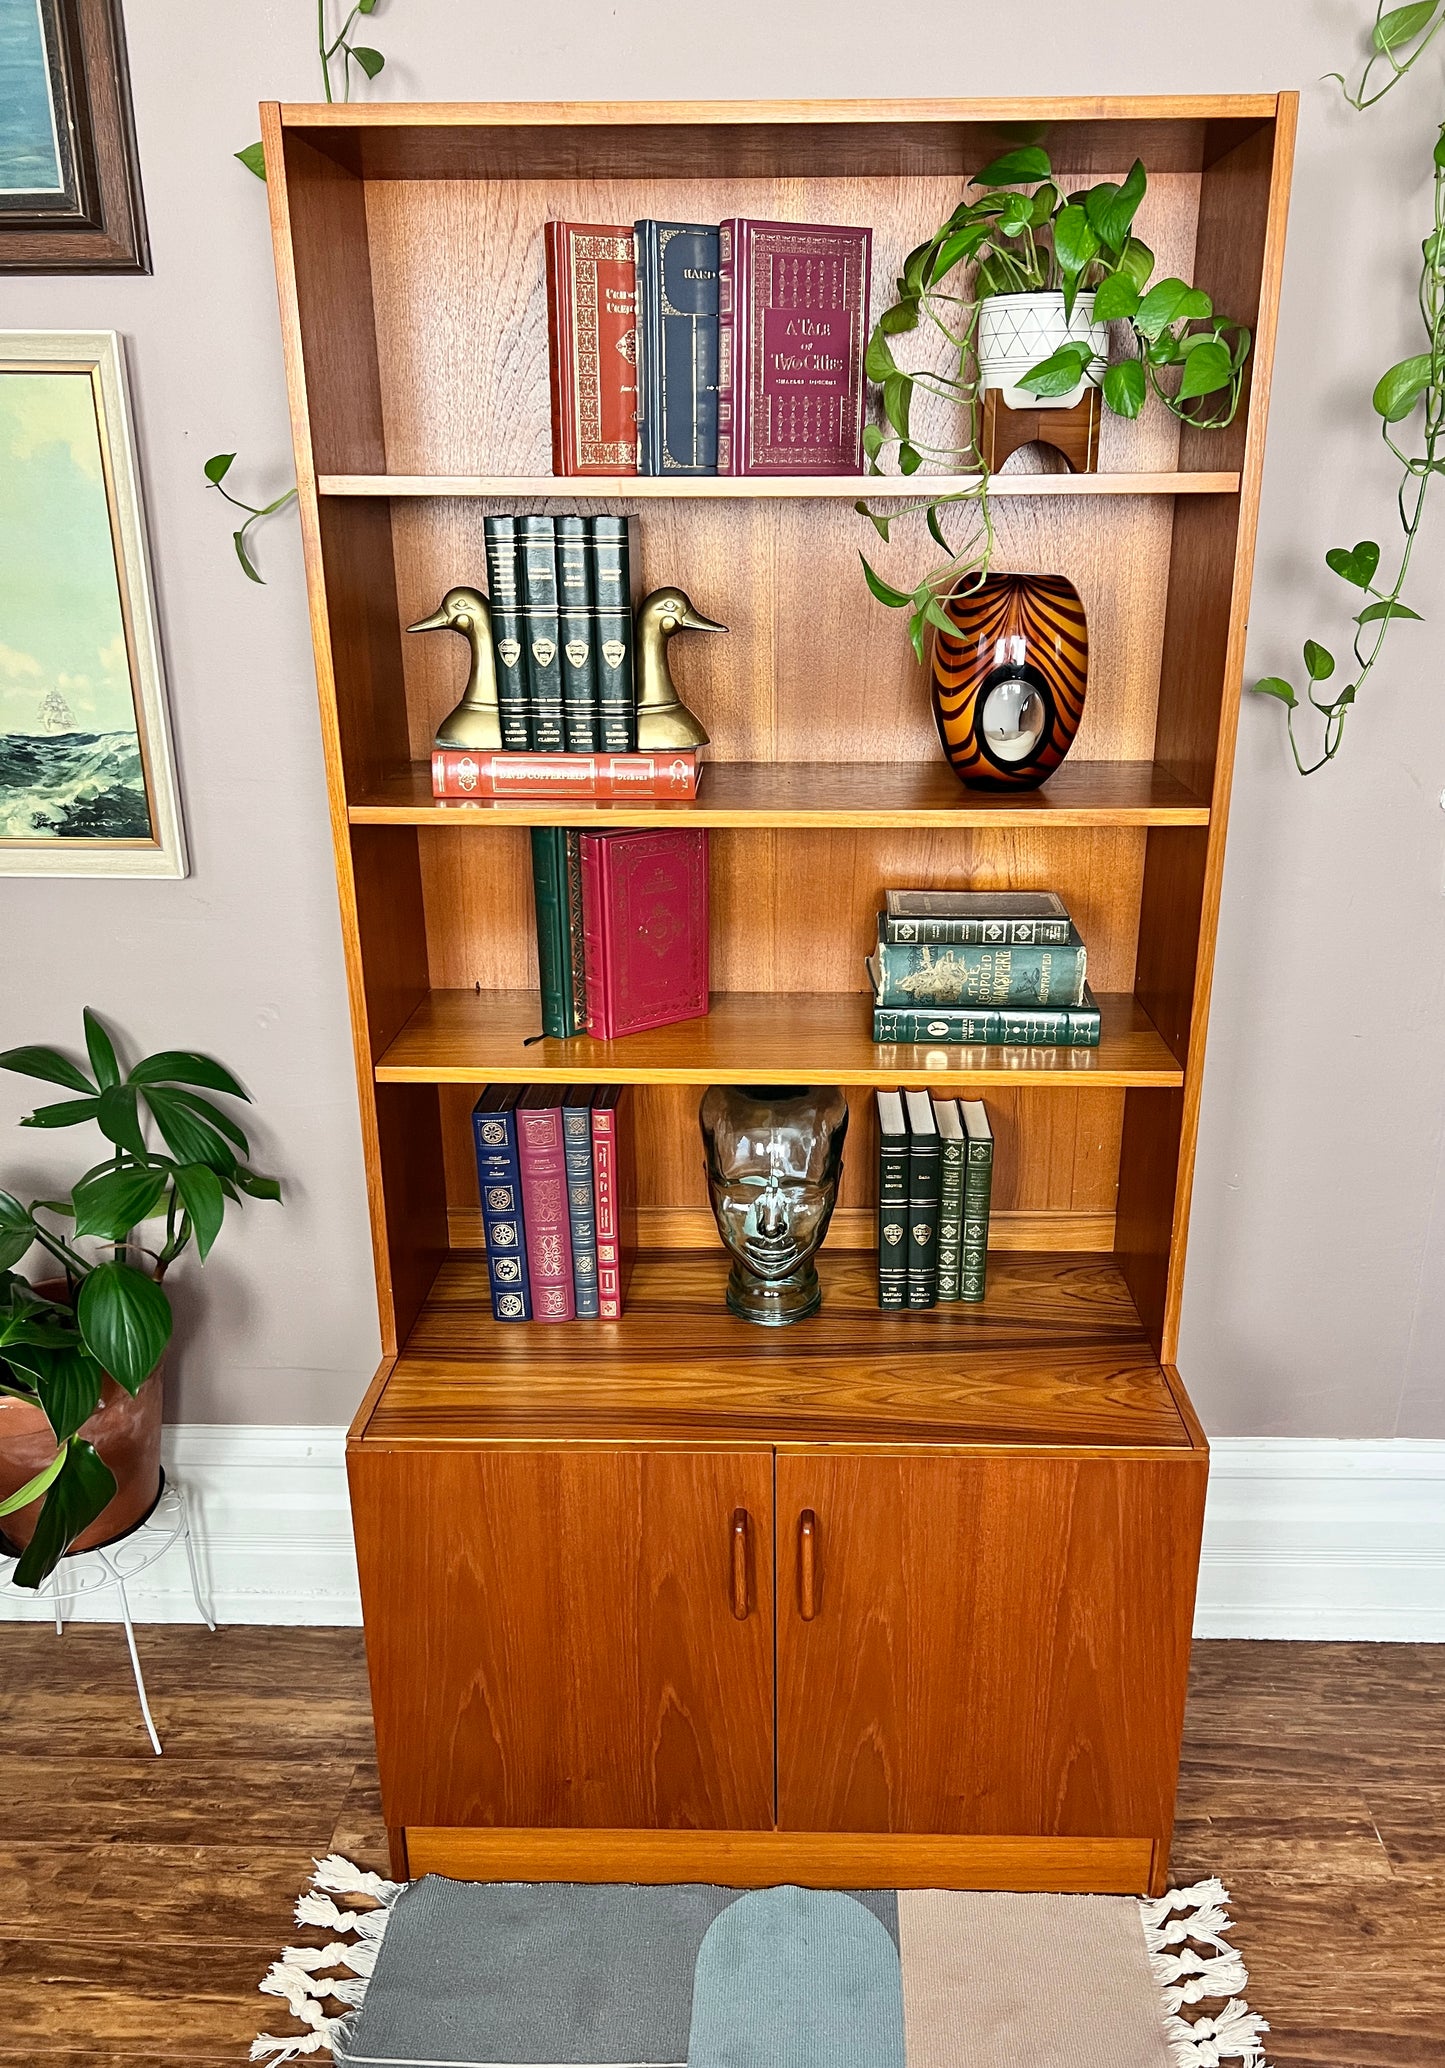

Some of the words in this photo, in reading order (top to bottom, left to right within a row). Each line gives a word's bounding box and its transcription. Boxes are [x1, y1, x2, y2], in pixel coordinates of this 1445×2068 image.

[784, 320, 798, 336] A
[967, 964, 980, 996] THE
[976, 954, 992, 1004] LEOPOLD
